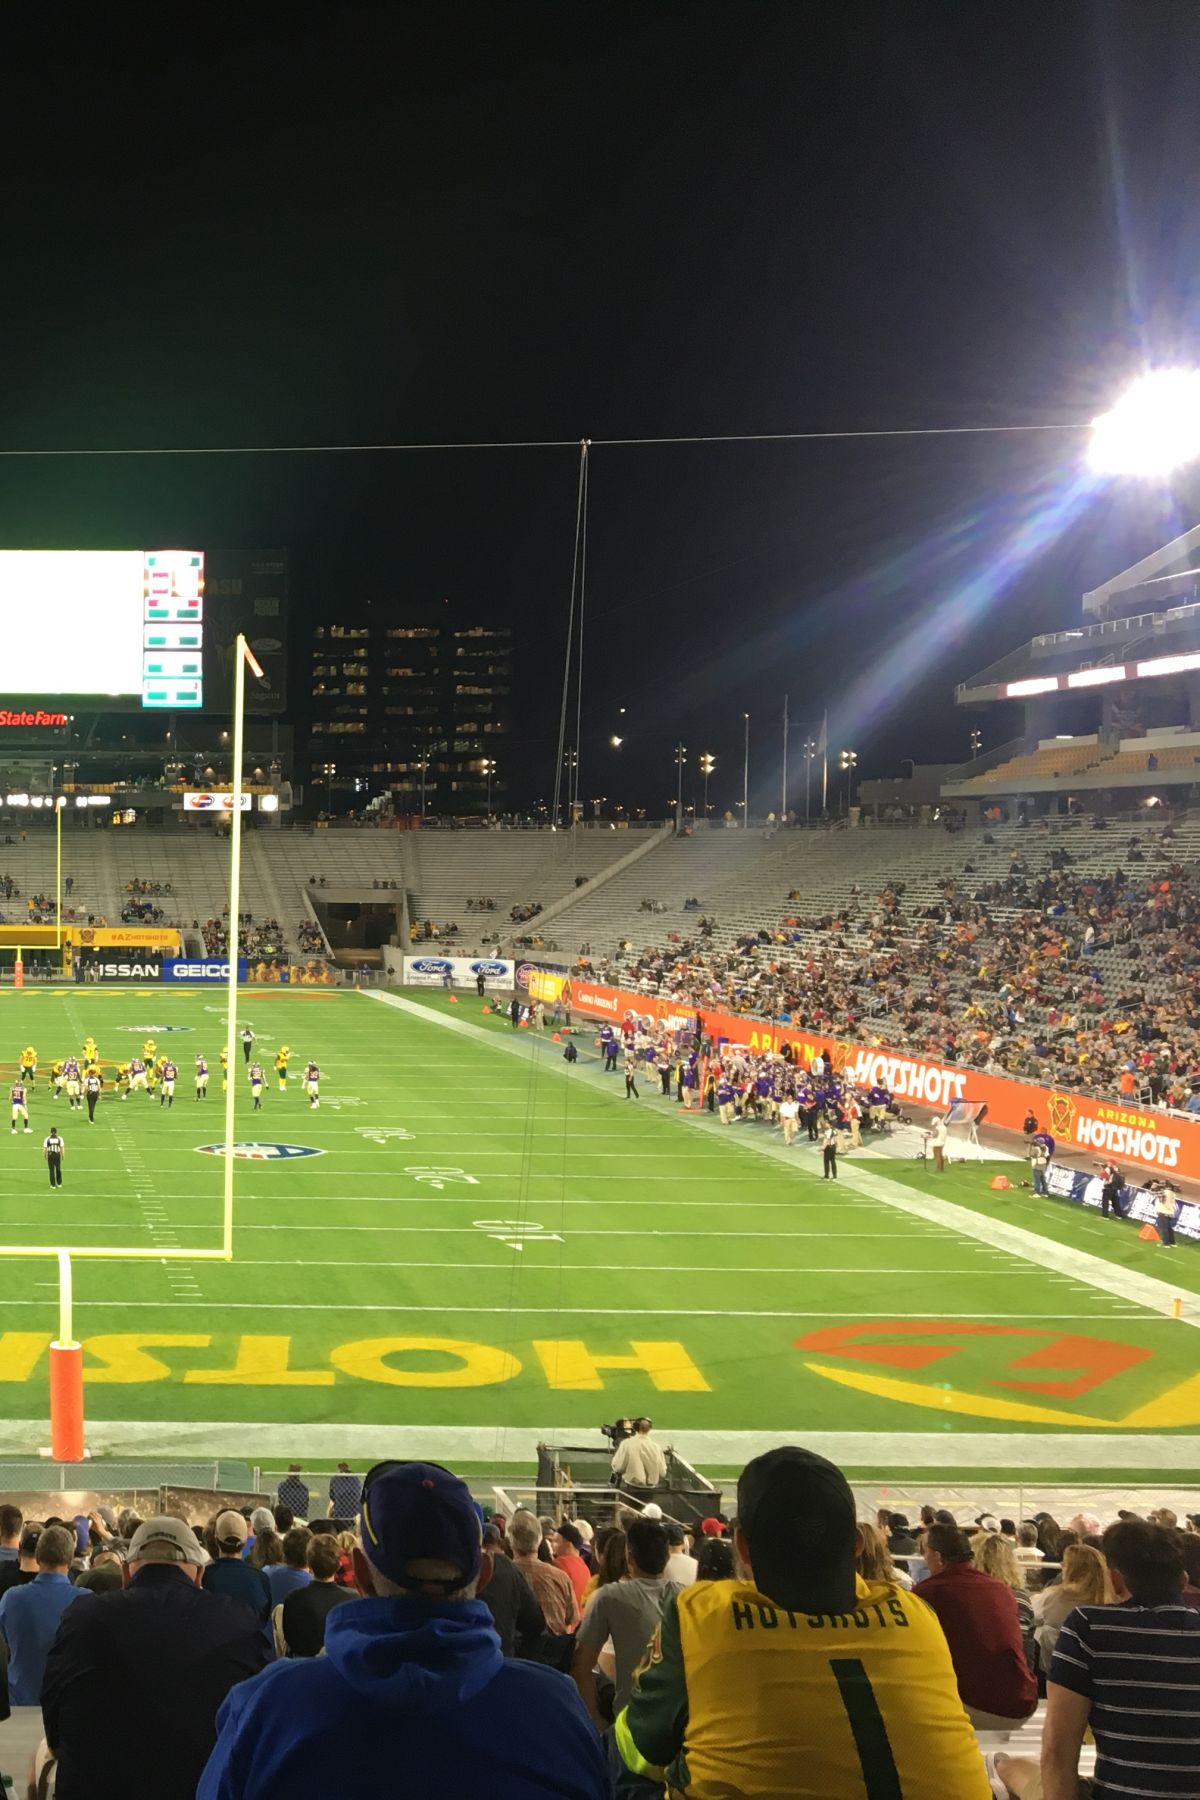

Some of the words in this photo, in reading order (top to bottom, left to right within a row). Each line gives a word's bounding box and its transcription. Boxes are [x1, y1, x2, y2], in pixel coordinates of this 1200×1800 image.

[99, 963, 159, 977] ISSAN
[419, 961, 447, 973] Ford
[477, 963, 501, 975] Ford
[1097, 1107, 1157, 1130] ARIZONA
[1076, 1115, 1181, 1167] HOTSHOTS
[472, 1220, 566, 1243] 10
[732, 1599, 910, 1630] HOTSHOTS
[828, 1658, 904, 1800] 1
